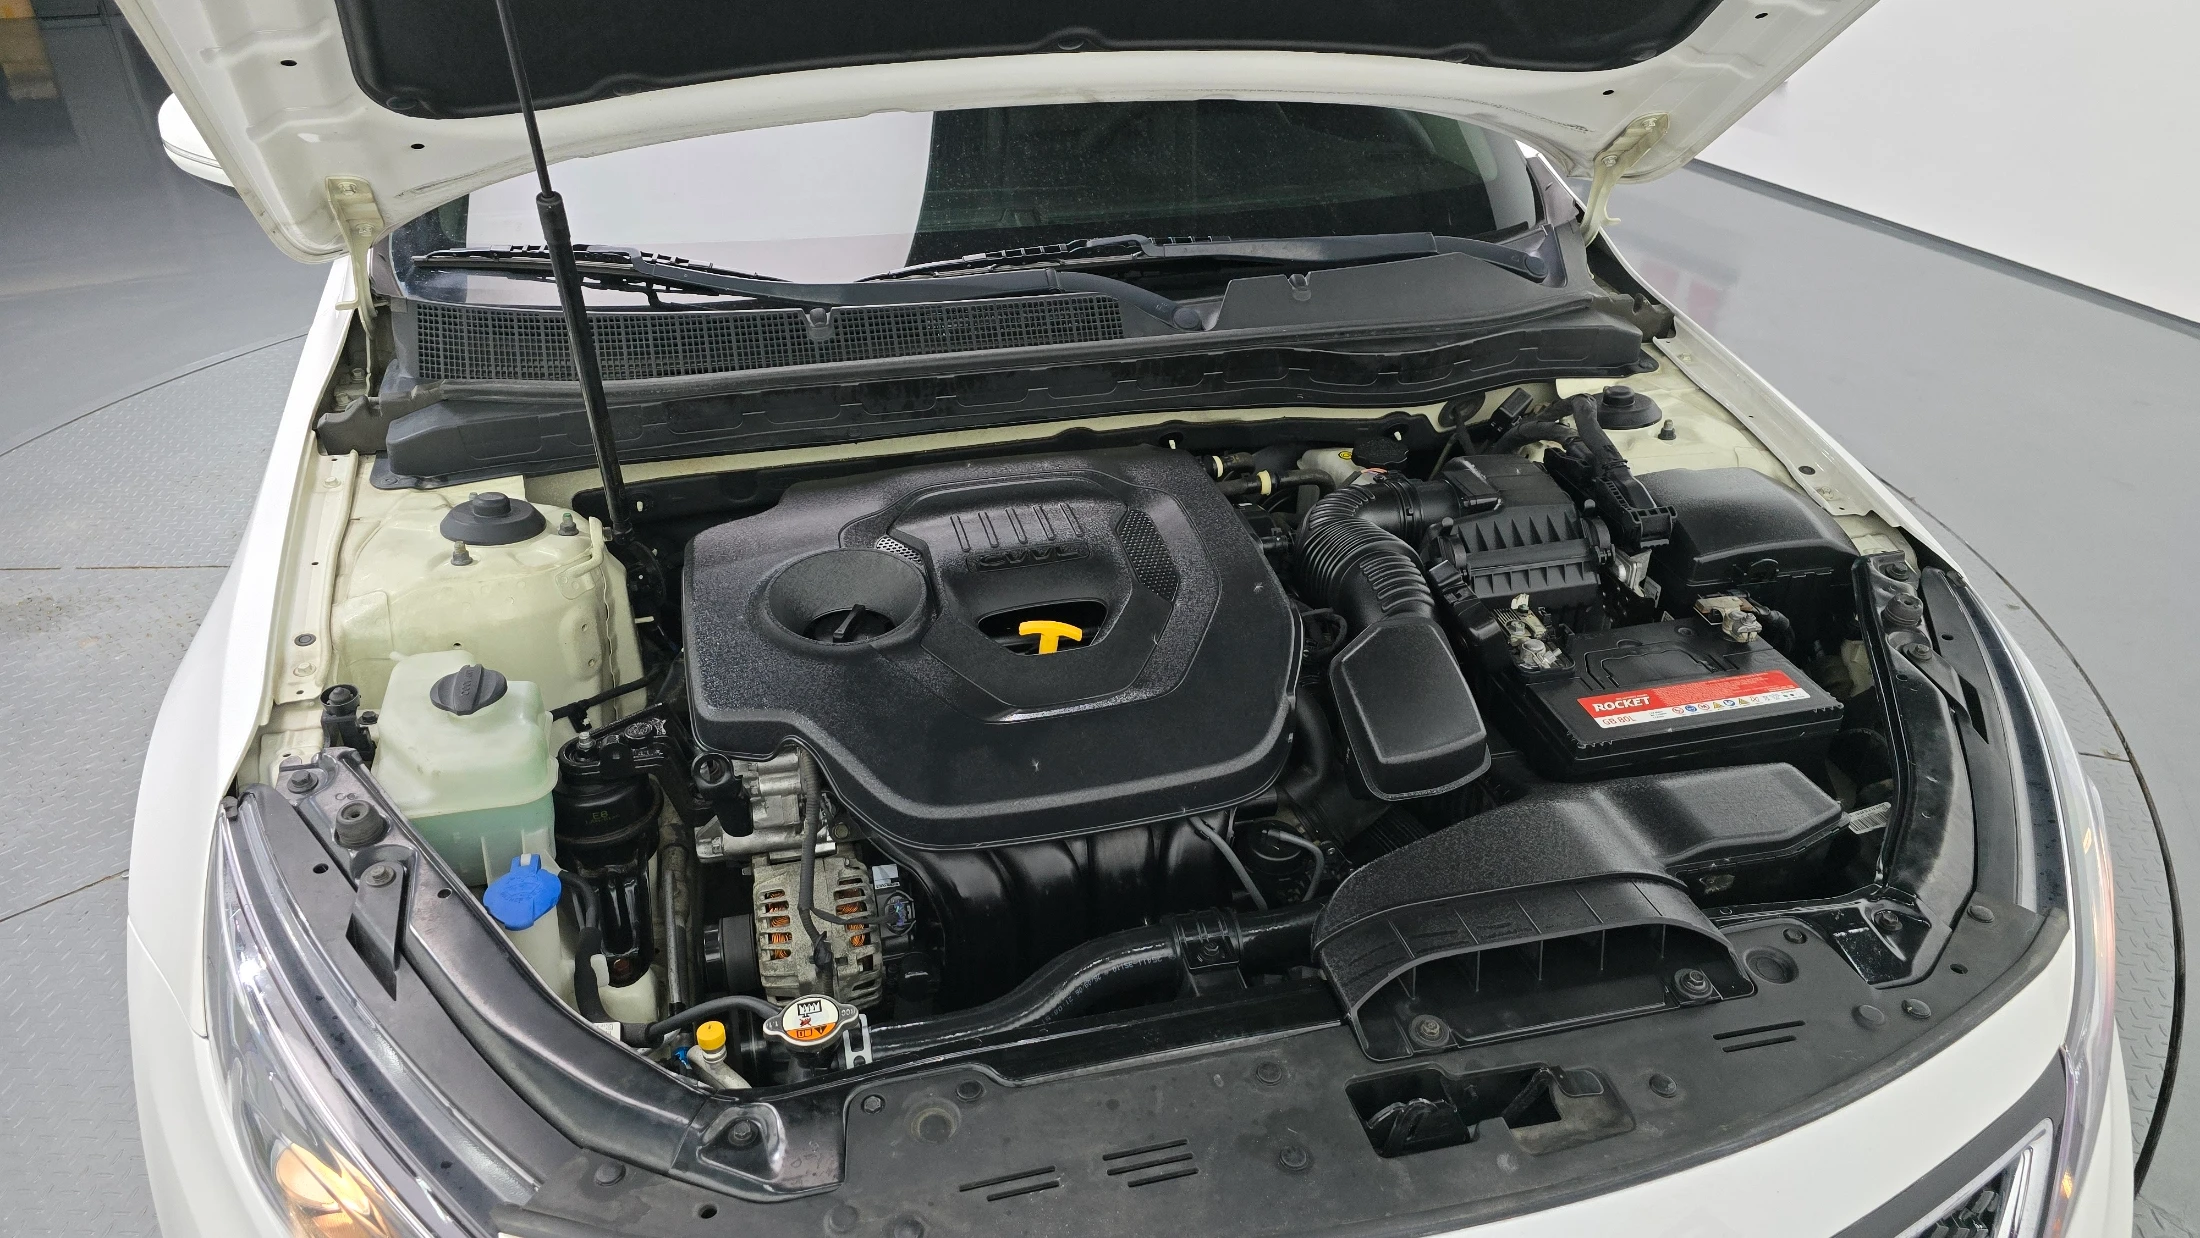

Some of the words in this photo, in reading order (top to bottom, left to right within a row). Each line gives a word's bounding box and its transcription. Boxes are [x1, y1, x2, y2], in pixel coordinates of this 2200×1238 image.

[1591, 695, 1651, 713] ROCKET
[1602, 715, 1617, 726] GB
[1619, 714, 1637, 723] 80L
